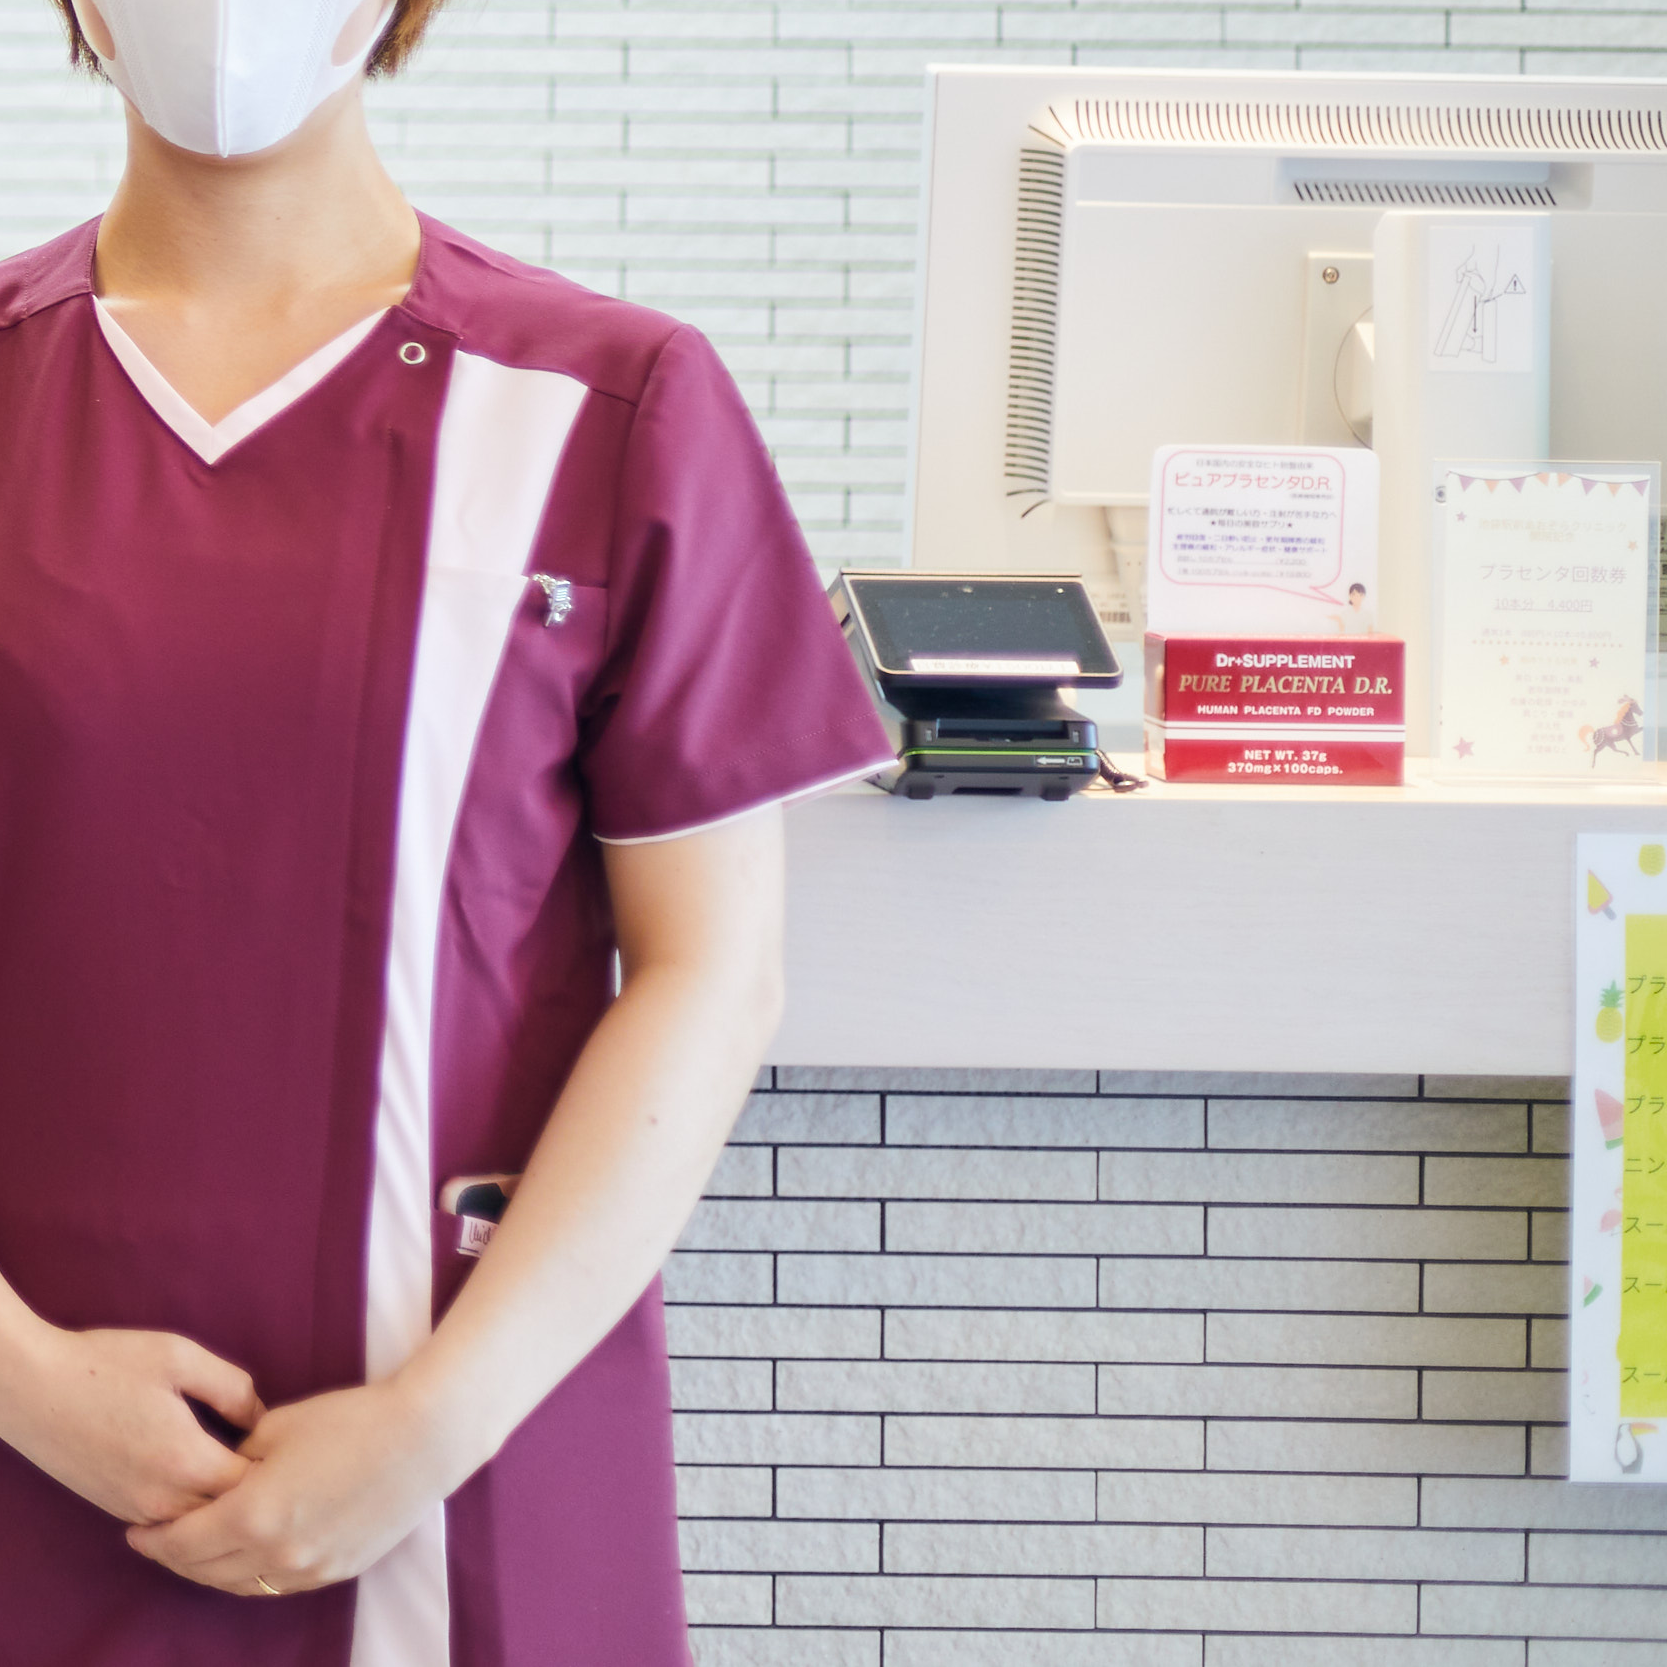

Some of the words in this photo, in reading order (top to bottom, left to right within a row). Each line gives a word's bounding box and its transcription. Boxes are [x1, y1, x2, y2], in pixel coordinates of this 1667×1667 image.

[1479, 564, 1627, 584] プラセンタ回数券
[1216, 653, 1355, 669] Dr+SUPPLEMENT
[1178, 674, 1232, 693] PURE
[1239, 675, 1346, 694] PLACENTA
[1353, 676, 1393, 695] D.R.
[1197, 705, 1238, 715] HUMAN
[1244, 705, 1301, 716] PLACENTA
[1307, 706, 1322, 716] FD
[1327, 707, 1375, 717] POWDER
[1244, 750, 1271, 761] NET
[1275, 750, 1299, 761] WT.
[1302, 750, 1327, 763] 37g
[1624, 1277, 1667, 1293] スー
[1622, 1366, 1667, 1383] スー
